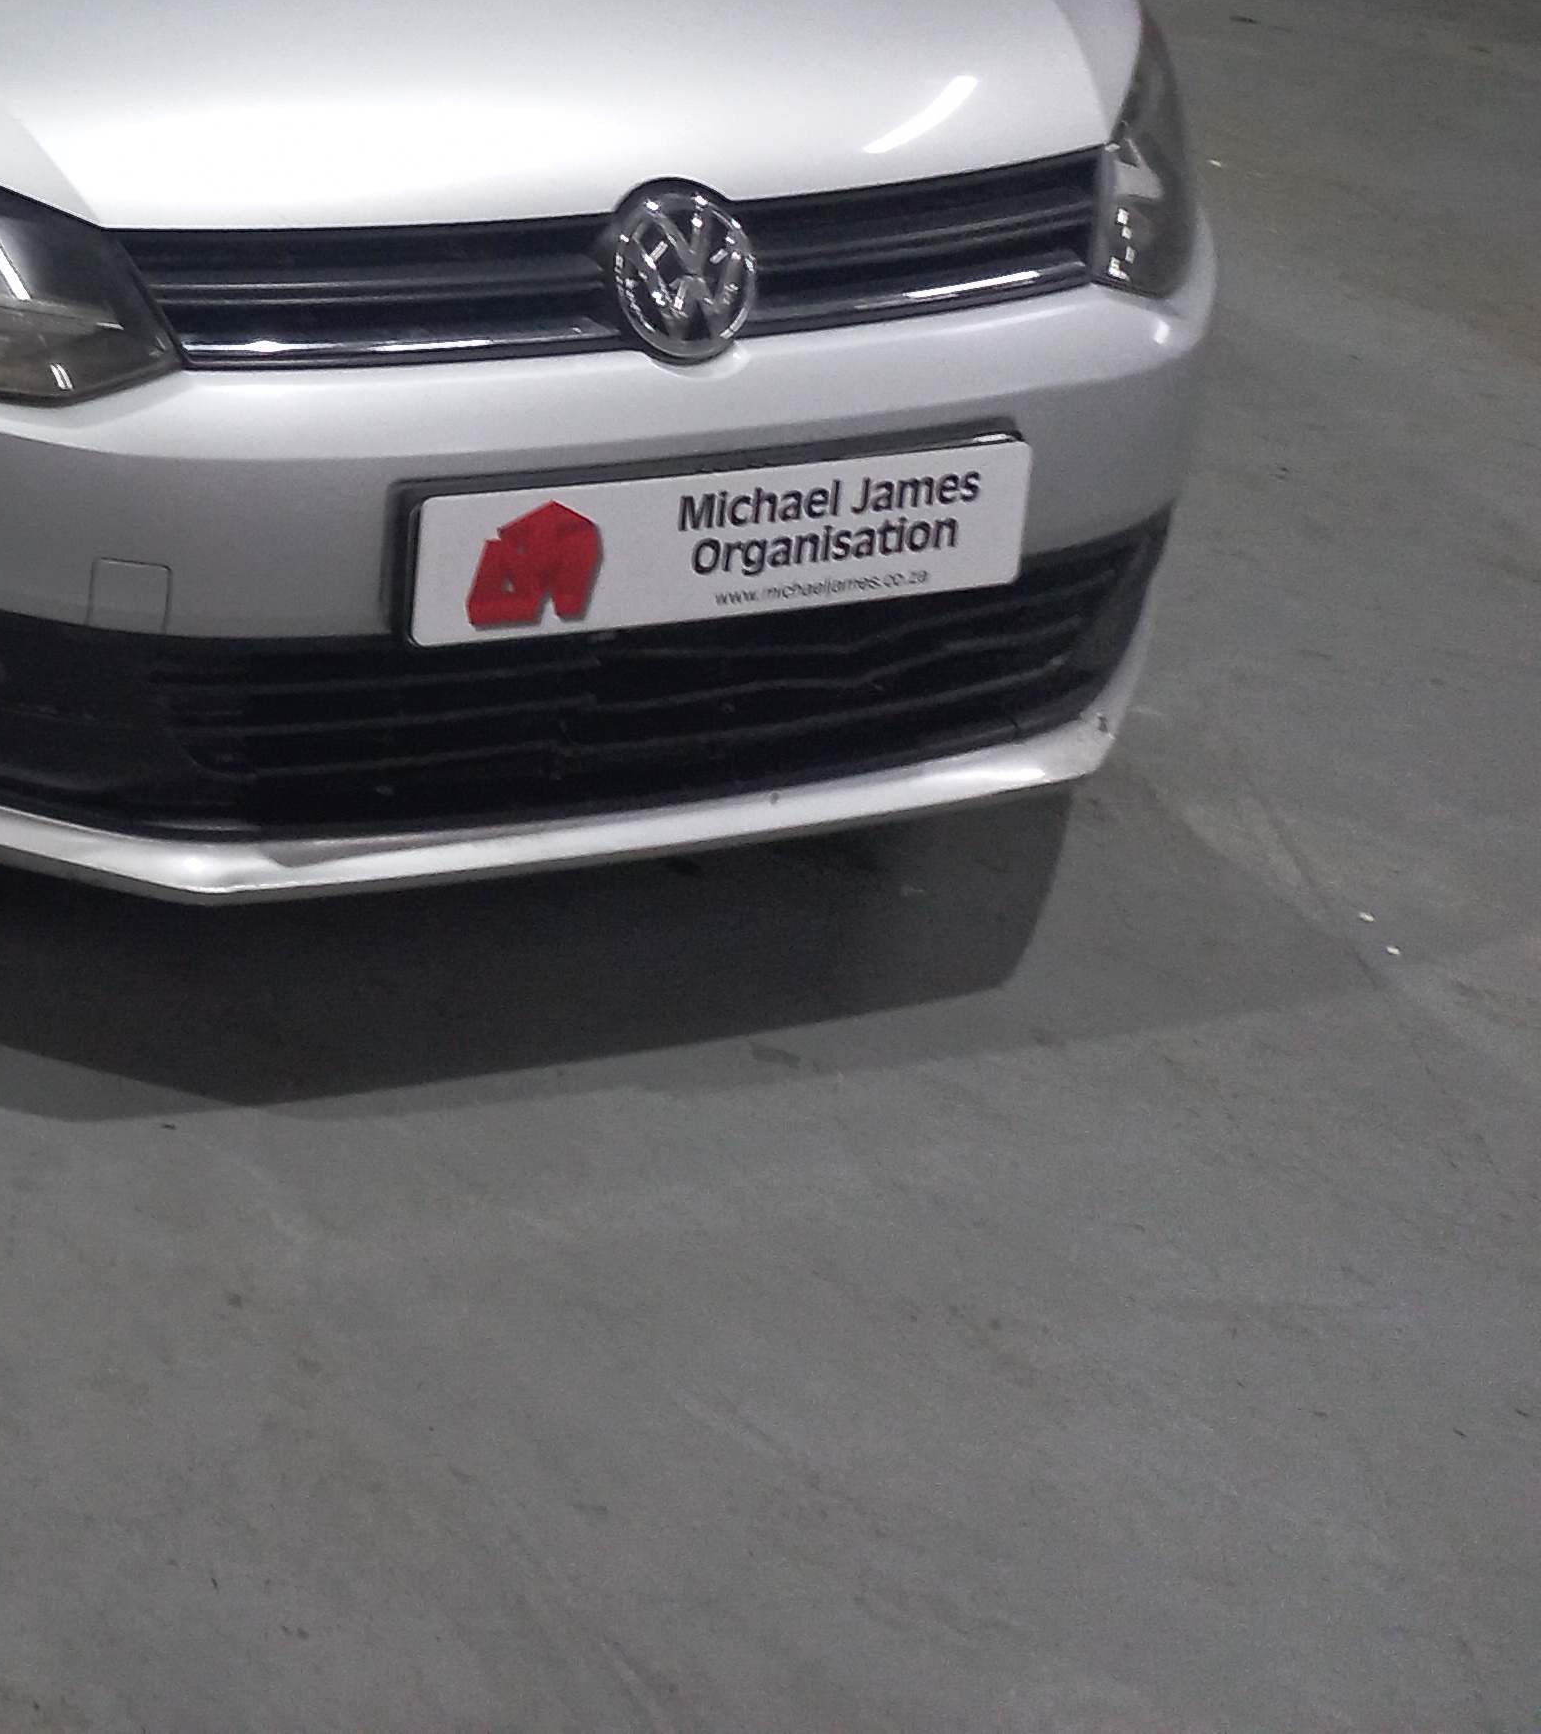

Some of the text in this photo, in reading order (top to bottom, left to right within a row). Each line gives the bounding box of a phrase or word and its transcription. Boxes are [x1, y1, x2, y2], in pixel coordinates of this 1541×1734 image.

[677, 470, 981, 532] Michael James
[690, 517, 959, 576] Organisation
